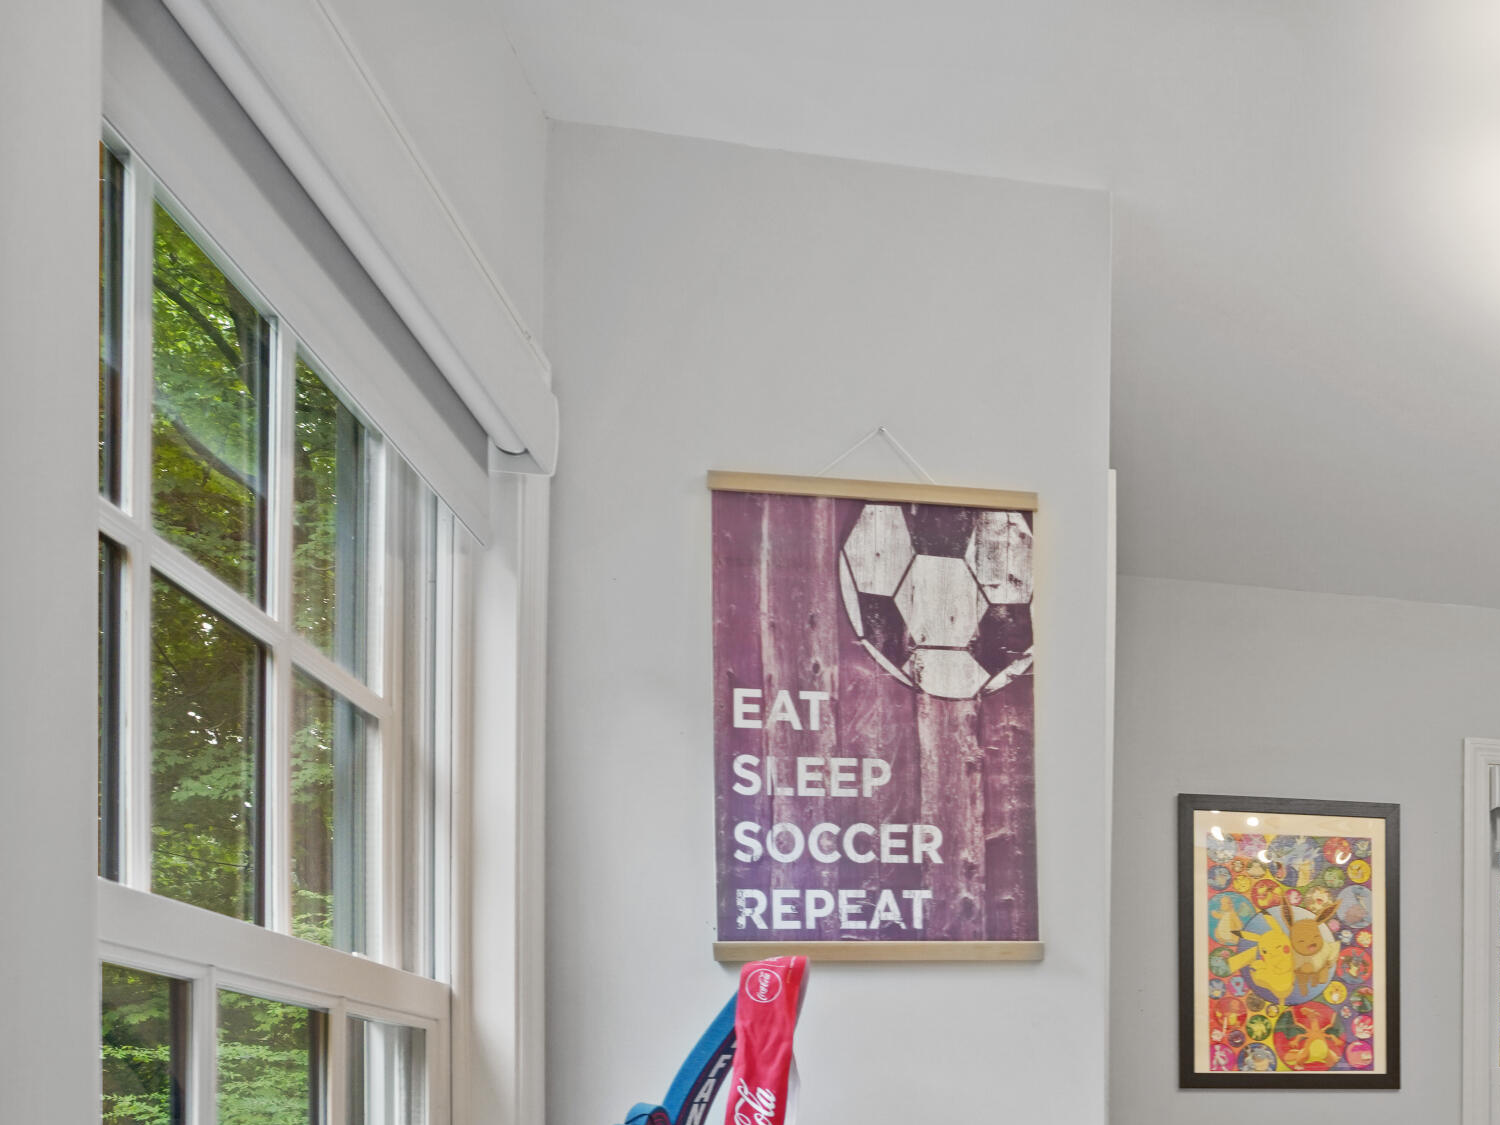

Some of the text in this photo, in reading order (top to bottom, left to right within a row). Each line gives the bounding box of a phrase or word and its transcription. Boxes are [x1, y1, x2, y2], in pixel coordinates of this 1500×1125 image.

[733, 688, 830, 731] EAT
[732, 754, 892, 798] SLEEP
[733, 821, 944, 865] SOCCER
[736, 888, 932, 930] REPEAT
